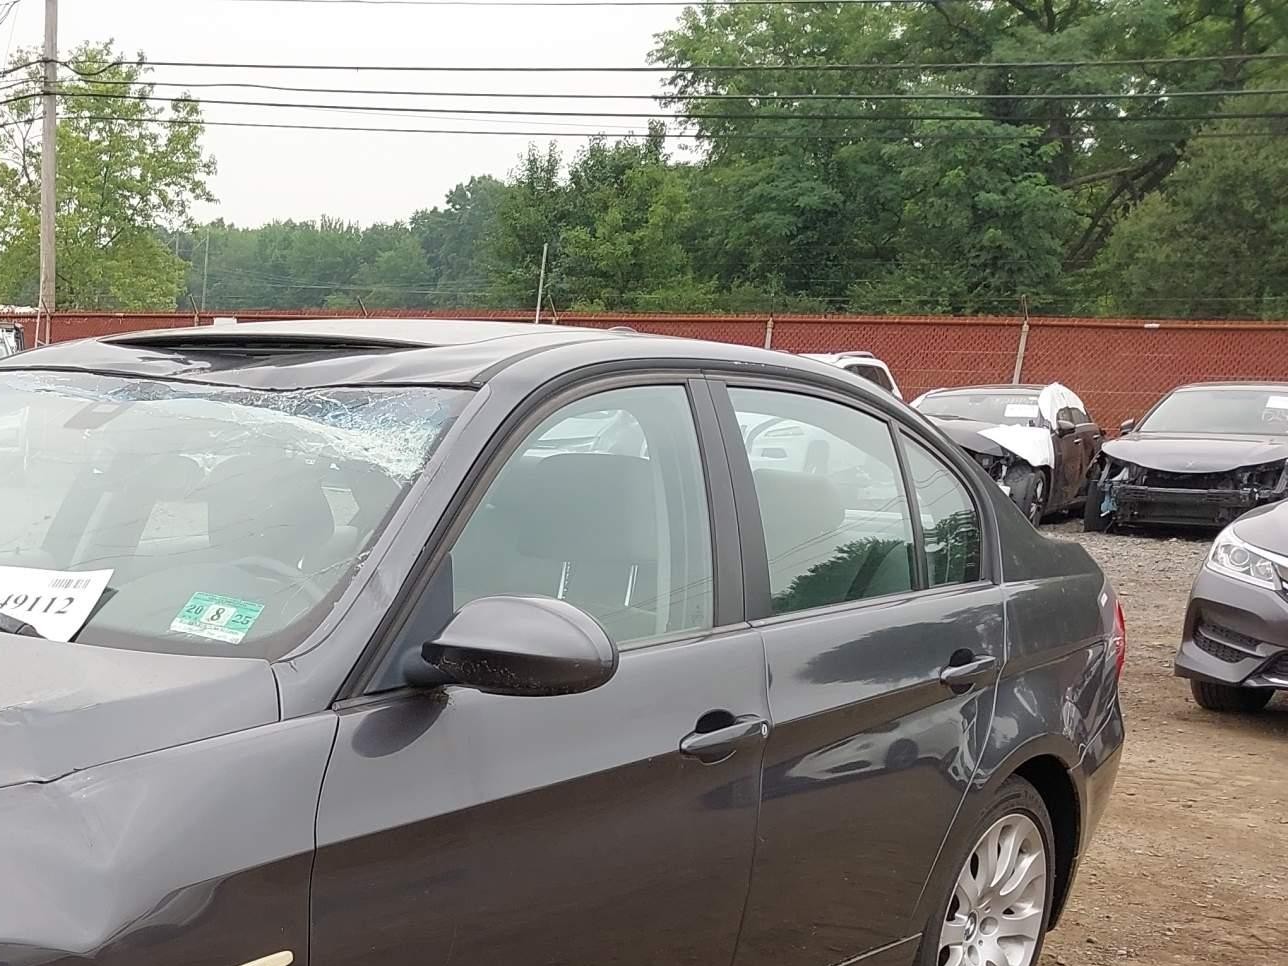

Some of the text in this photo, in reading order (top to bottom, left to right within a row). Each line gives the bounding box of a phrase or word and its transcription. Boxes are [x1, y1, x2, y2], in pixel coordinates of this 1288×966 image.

[185, 604, 253, 625] 20 8 25
